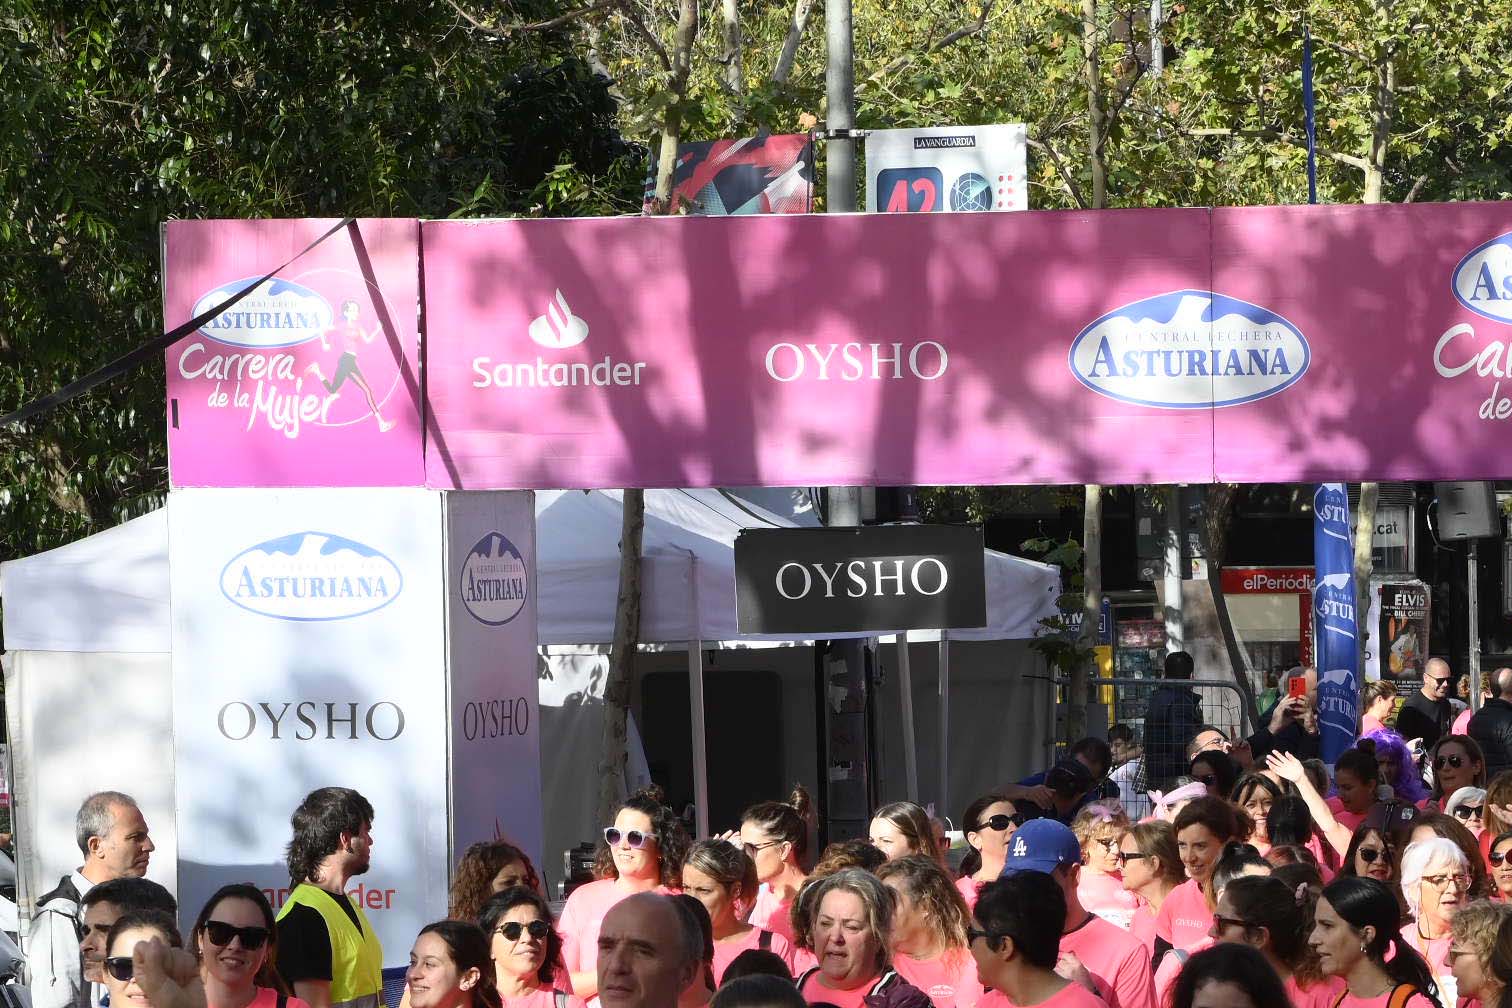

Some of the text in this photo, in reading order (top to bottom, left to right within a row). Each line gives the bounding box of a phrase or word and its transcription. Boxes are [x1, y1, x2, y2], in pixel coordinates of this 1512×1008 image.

[927, 137, 976, 148] VANGUARDIA
[202, 303, 321, 329] ASTURIANA
[178, 342, 296, 380] Carrera
[472, 356, 647, 388] Santander
[765, 341, 949, 382] OYSHO
[1087, 334, 1292, 377] ASTURIANA
[207, 377, 341, 439] de la Mujer
[234, 565, 389, 598] ASTURIANA
[466, 568, 525, 602] ASTURIANA
[774, 557, 949, 599] OYSHO
[1394, 594, 1425, 607] ELVIS
[217, 701, 406, 741] OYSHO
[463, 697, 529, 742] OYSHO
[1012, 837, 1027, 857] LA
